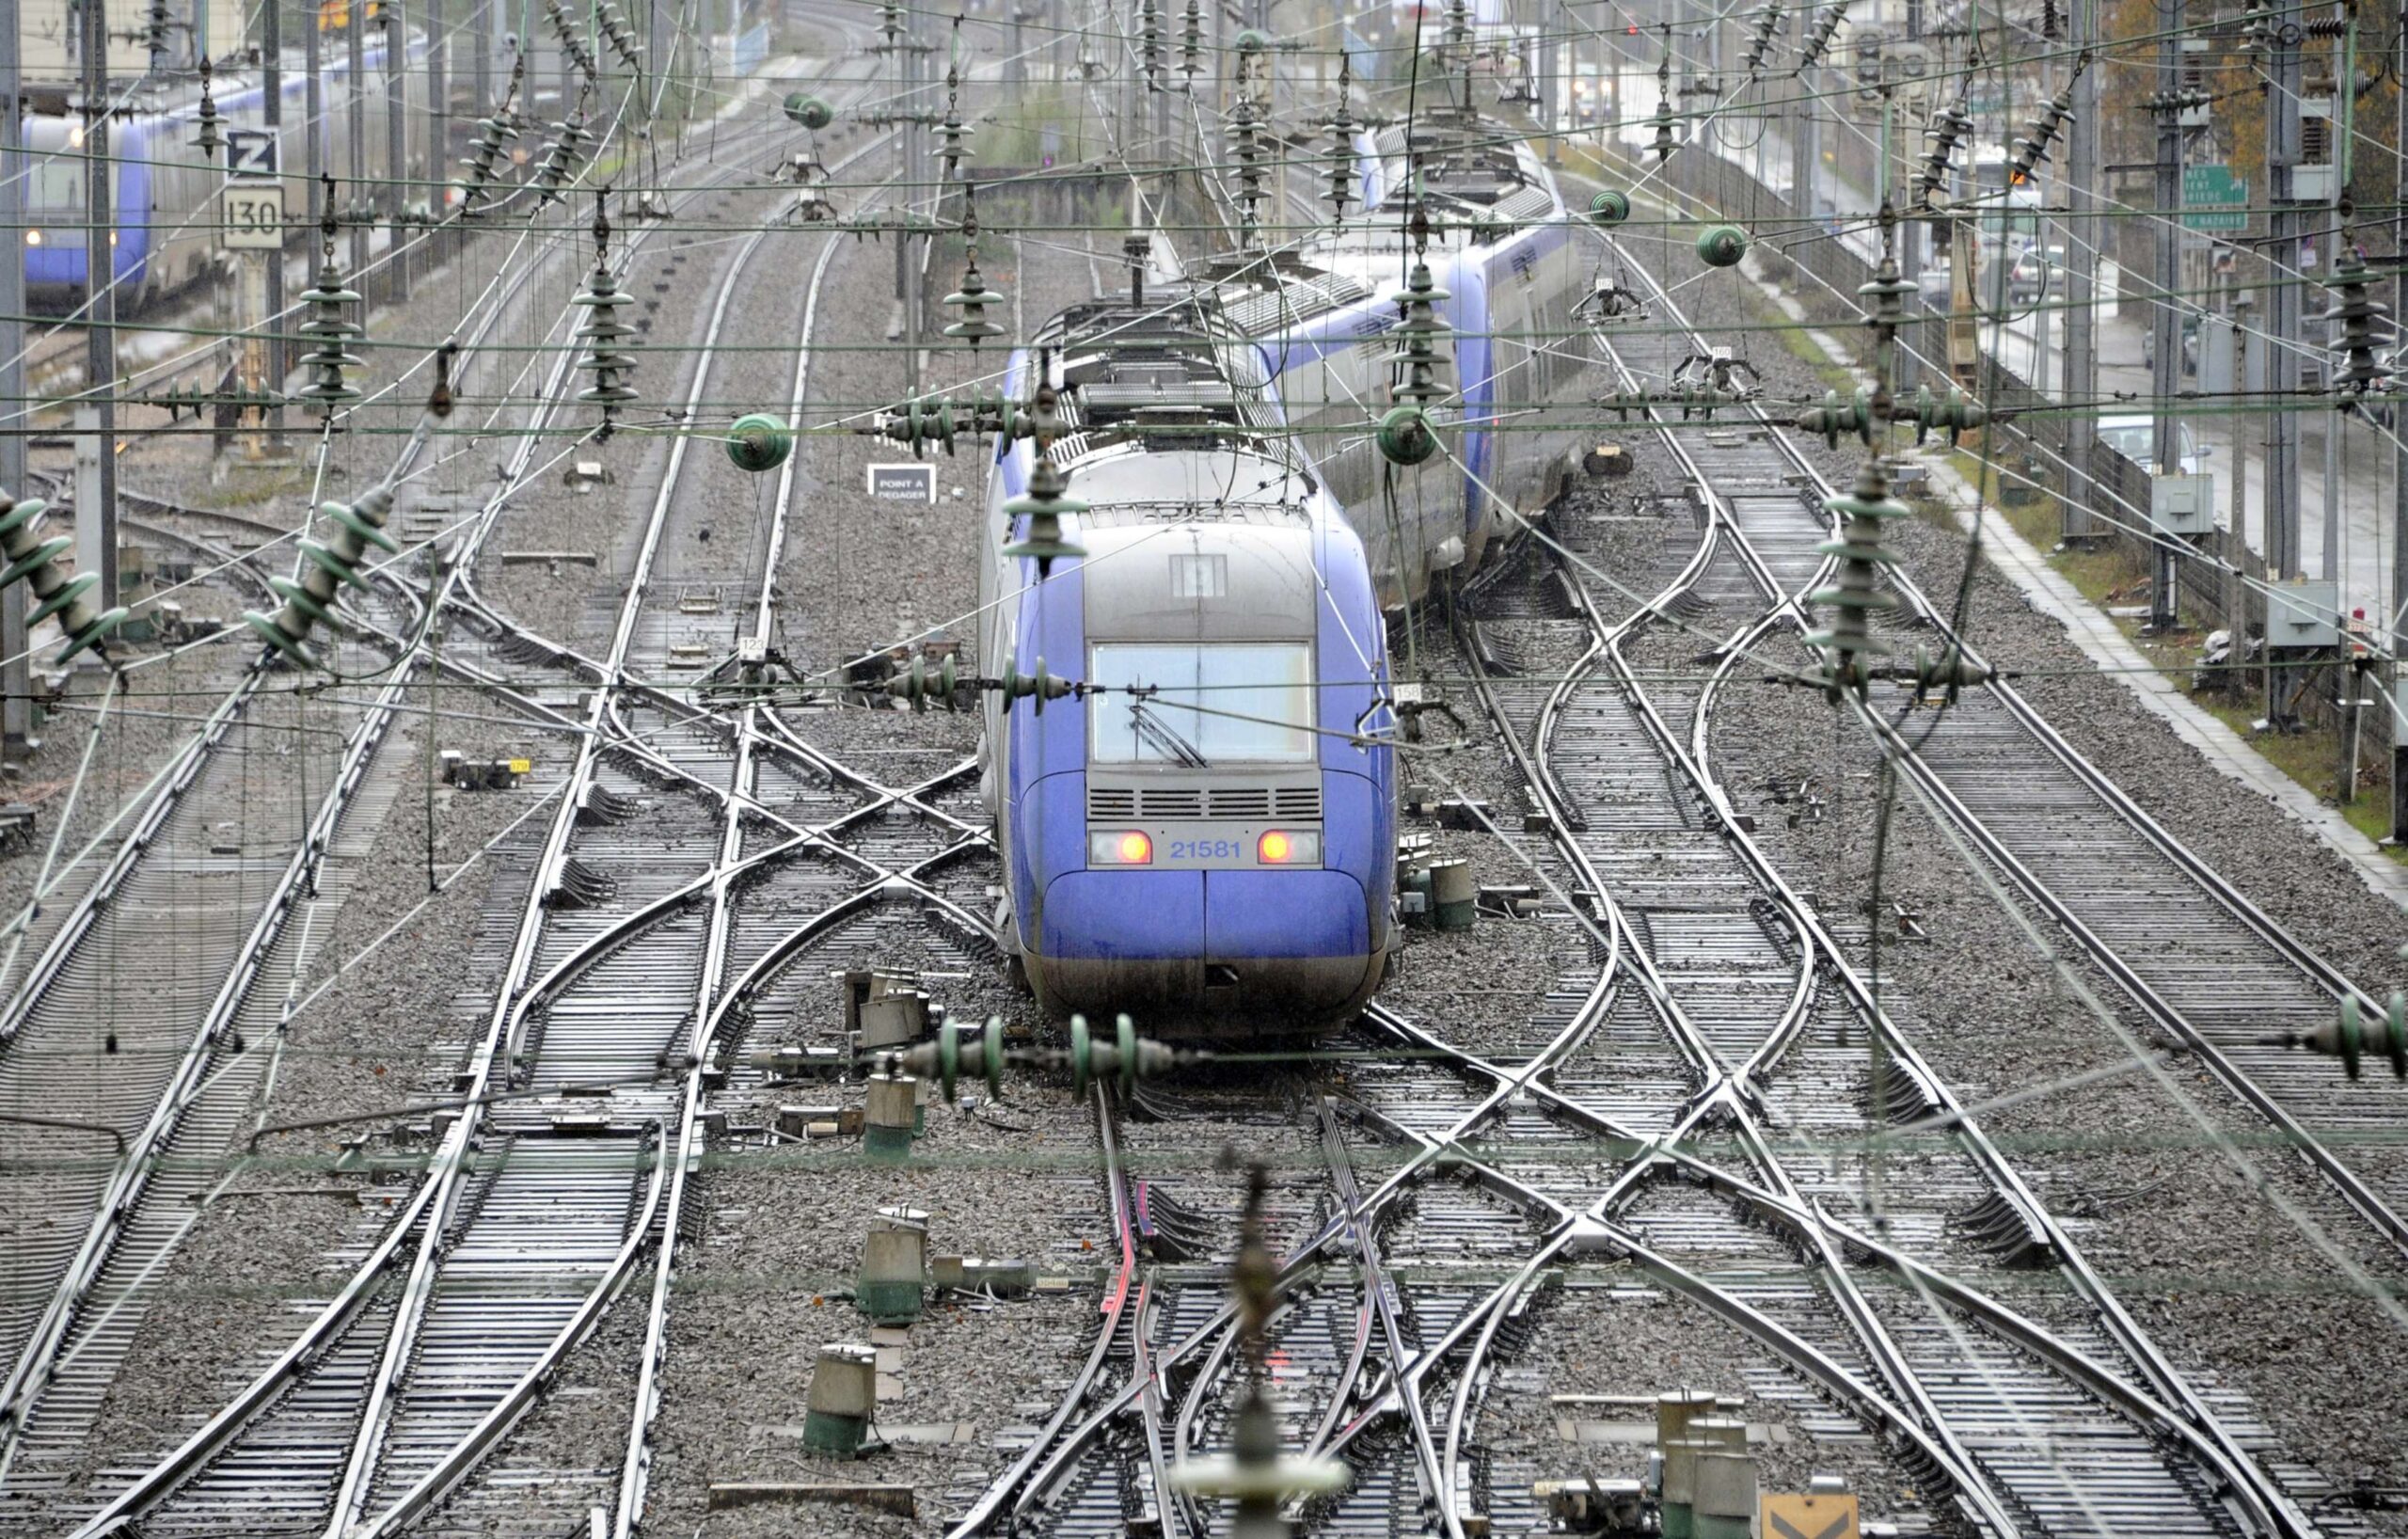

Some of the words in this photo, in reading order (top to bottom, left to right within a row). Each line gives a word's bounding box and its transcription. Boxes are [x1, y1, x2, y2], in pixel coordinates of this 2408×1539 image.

[235, 136, 269, 173] Z
[229, 201, 277, 235] 130
[879, 480, 912, 488] POINT
[915, 480, 924, 488] A
[878, 490, 927, 500] DEGAGER
[743, 639, 764, 650] 123
[1398, 685, 1419, 698] 158
[1169, 840, 1242, 859] 21581
